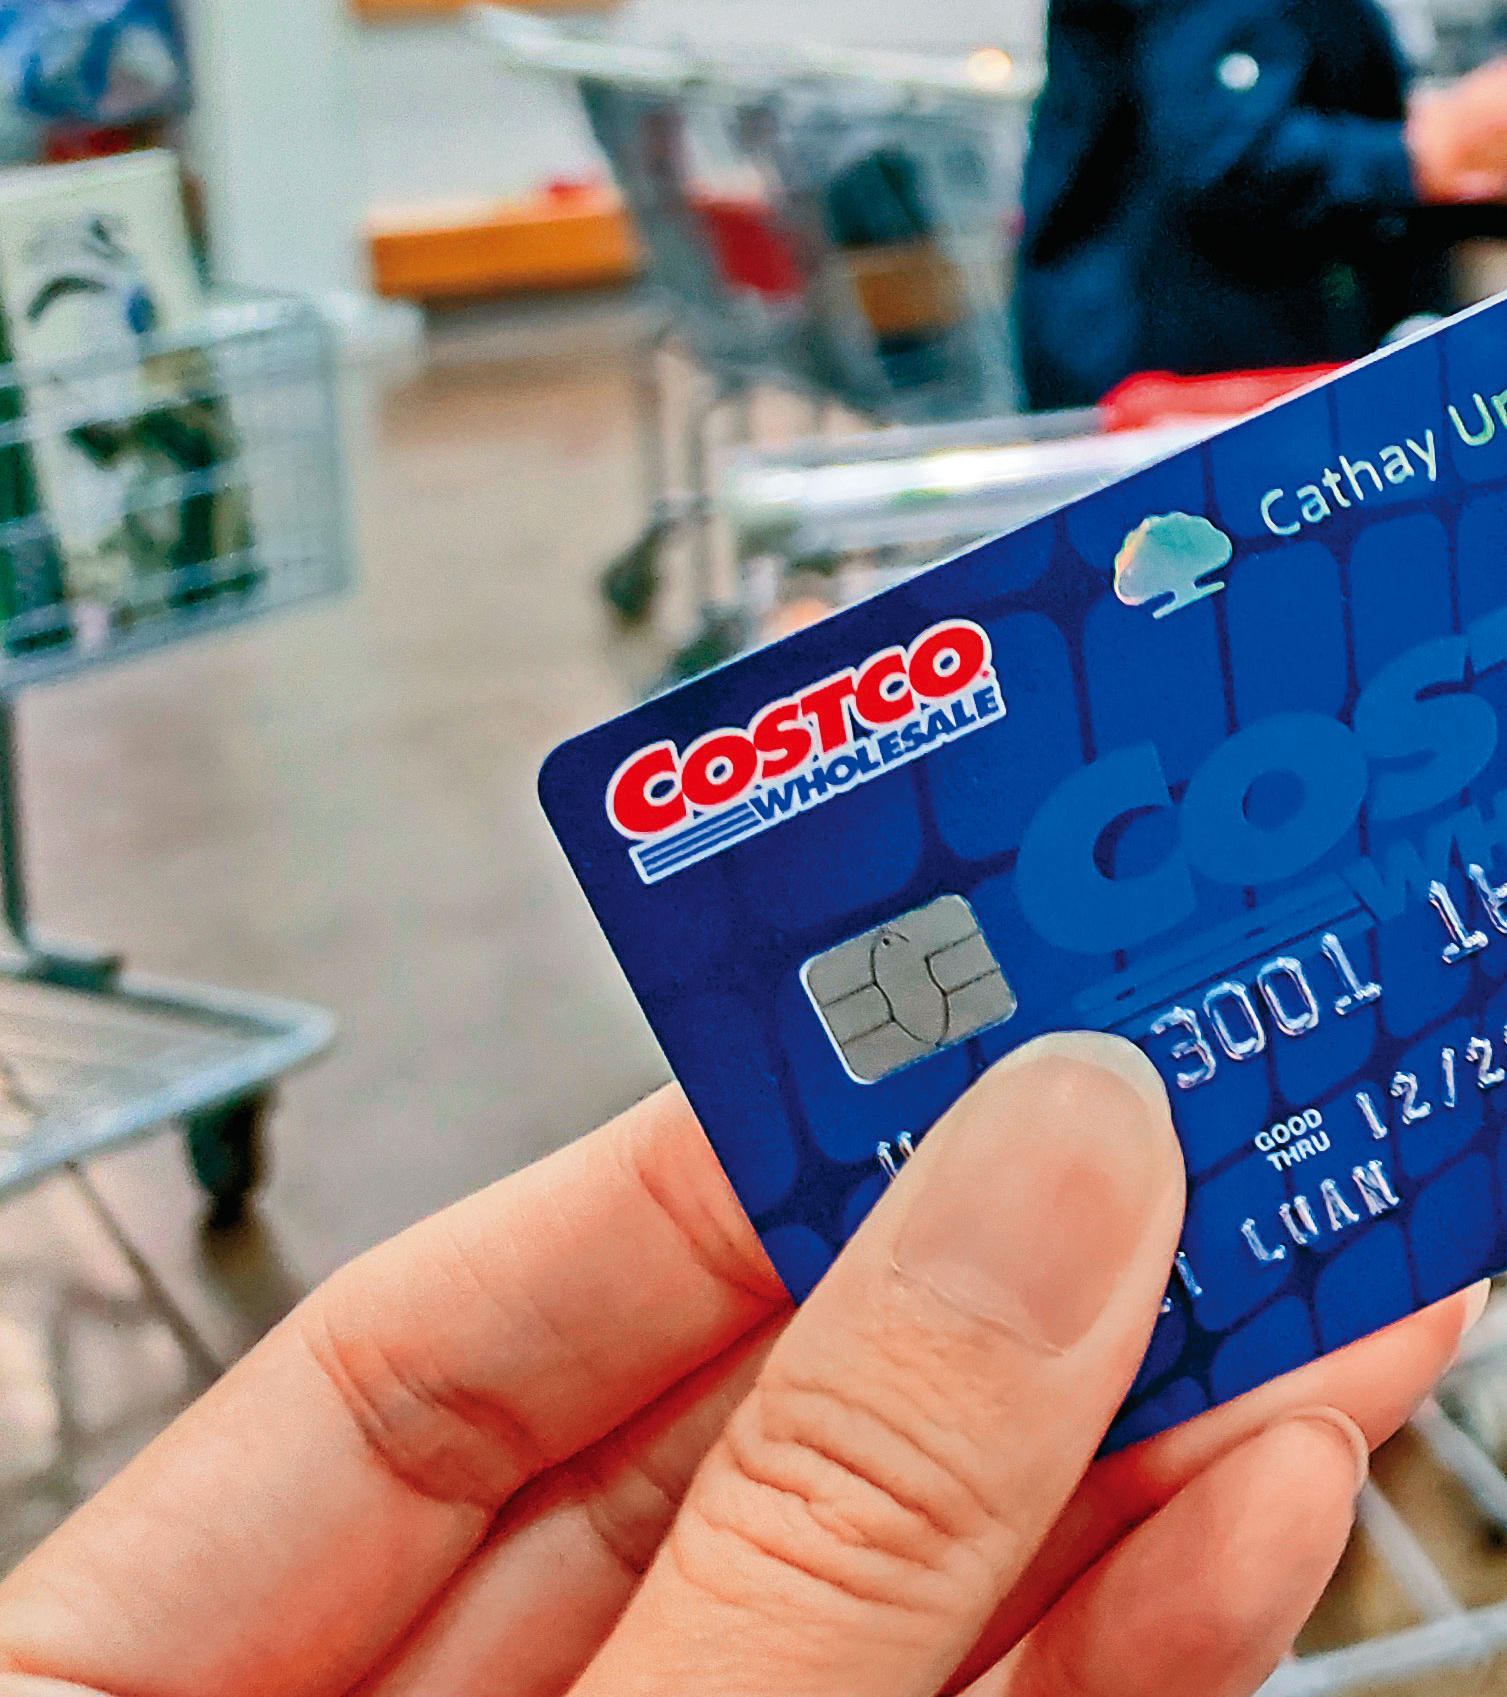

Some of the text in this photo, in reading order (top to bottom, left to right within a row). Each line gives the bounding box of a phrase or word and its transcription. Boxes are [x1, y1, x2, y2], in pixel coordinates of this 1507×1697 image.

[1259, 429, 1439, 537] Cathay
[609, 623, 988, 835] COSTCO
[751, 685, 999, 822] WHOLESALE
[1149, 933, 1384, 1090] 3001
[1253, 1107, 1324, 1153] GOOD
[1265, 1130, 1332, 1172] THRU
[1239, 1159, 1401, 1262] LUAN
